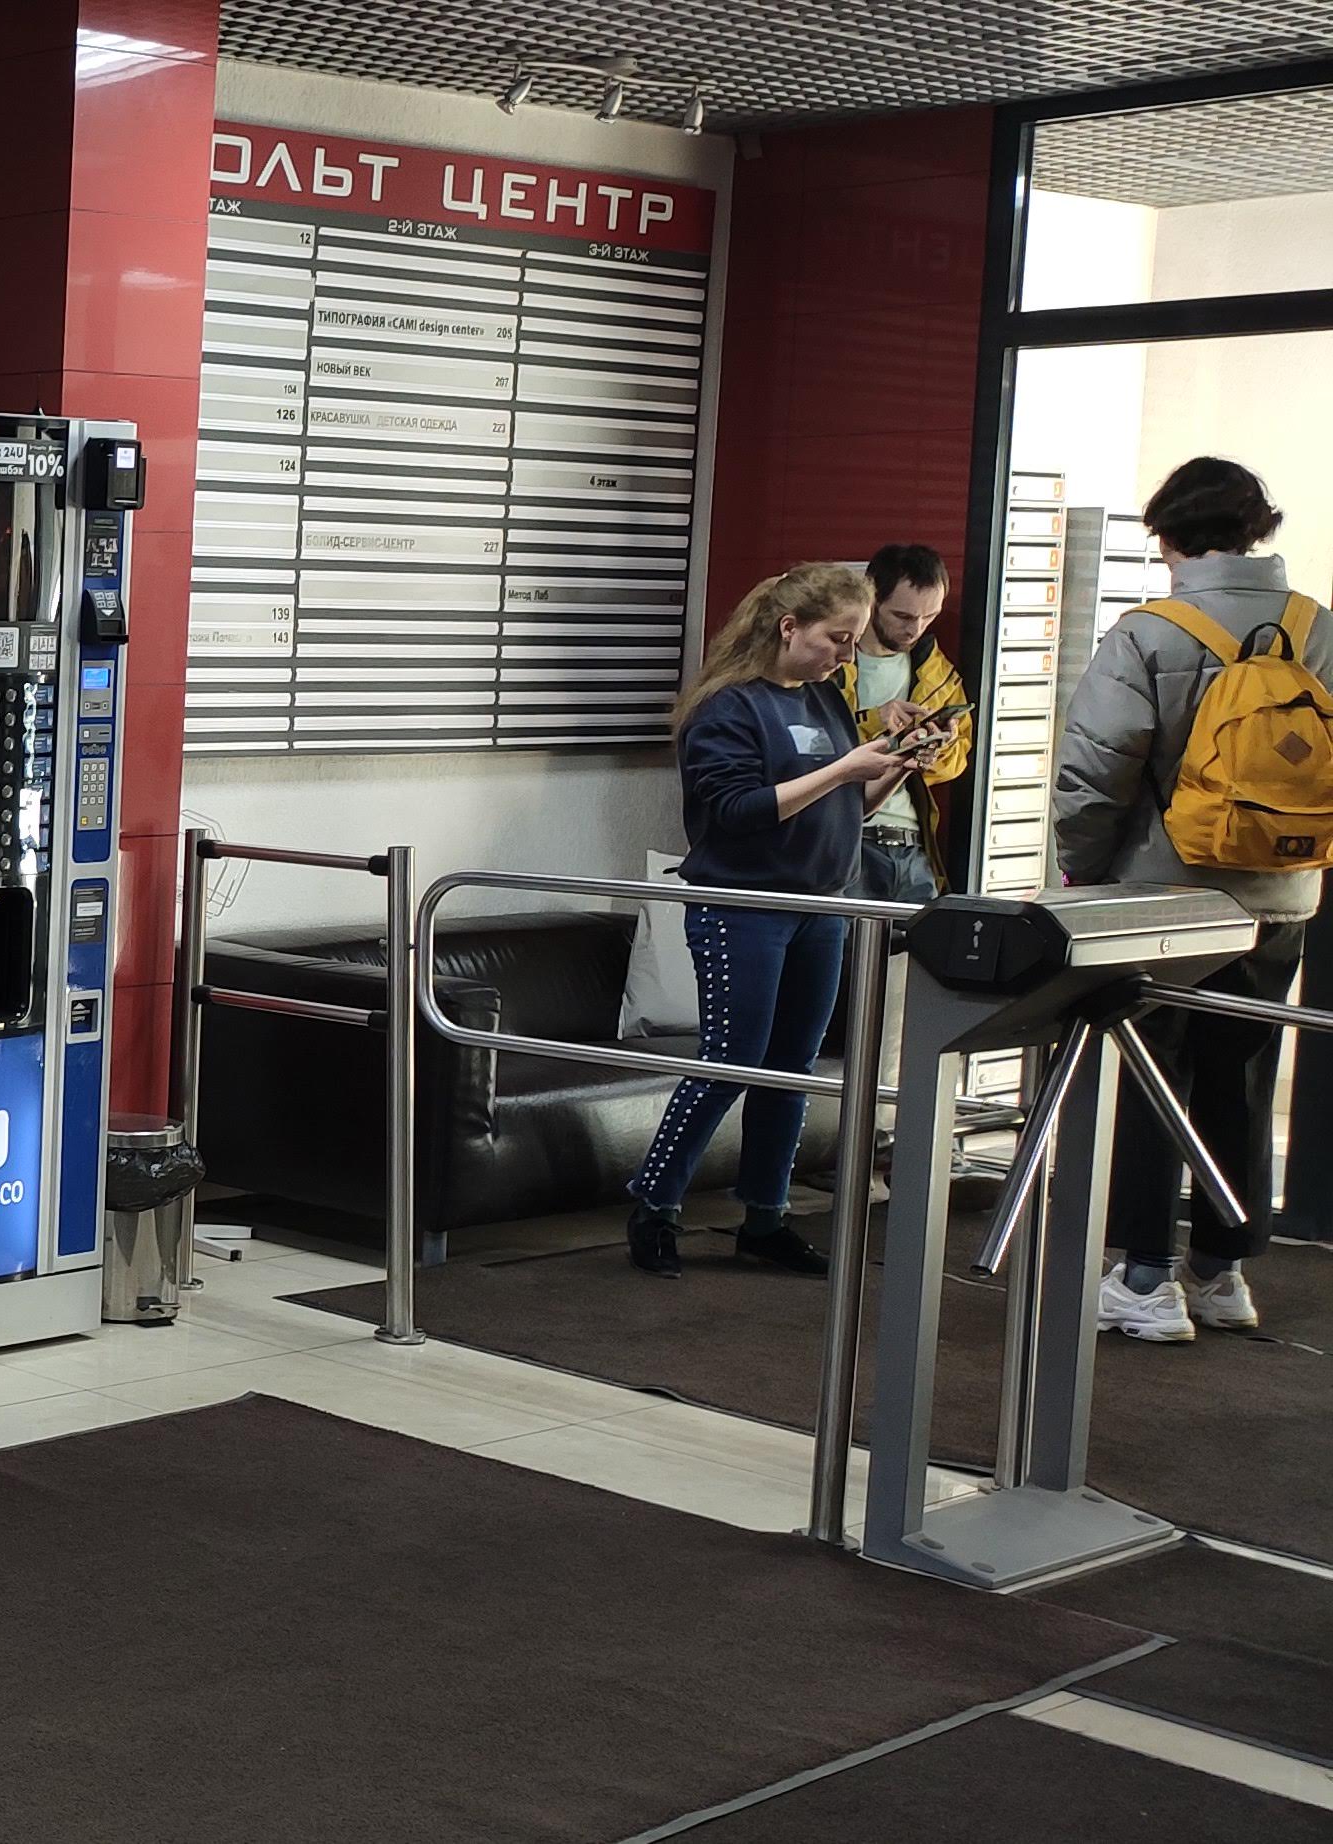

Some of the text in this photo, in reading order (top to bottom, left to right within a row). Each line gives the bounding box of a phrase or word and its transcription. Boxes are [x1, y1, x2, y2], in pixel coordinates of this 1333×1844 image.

[442, 164, 675, 235] ЦЕНТР
[388, 219, 457, 240] 2-Й ЭТАЖ
[299, 232, 311, 245] 12
[588, 243, 649, 262] 3-Й ЭТАЖ
[318, 310, 385, 327] ТИПОГРАФИЯ
[419, 320, 449, 336] design
[496, 327, 513, 339] 205
[316, 361, 351, 375] НОВЫЙ
[353, 365, 372, 377] ВЕК
[276, 408, 296, 421] 126
[310, 410, 370, 425] КРАСАВУШКА
[3, 446, 24, 458] 24U
[27, 453, 65, 478] 10%
[279, 459, 296, 471] 124
[589, 476, 618, 488] 4 этаж
[508, 589, 549, 602] Метод Лаб
[271, 607, 290, 620] 139
[273, 631, 289, 644] 143
